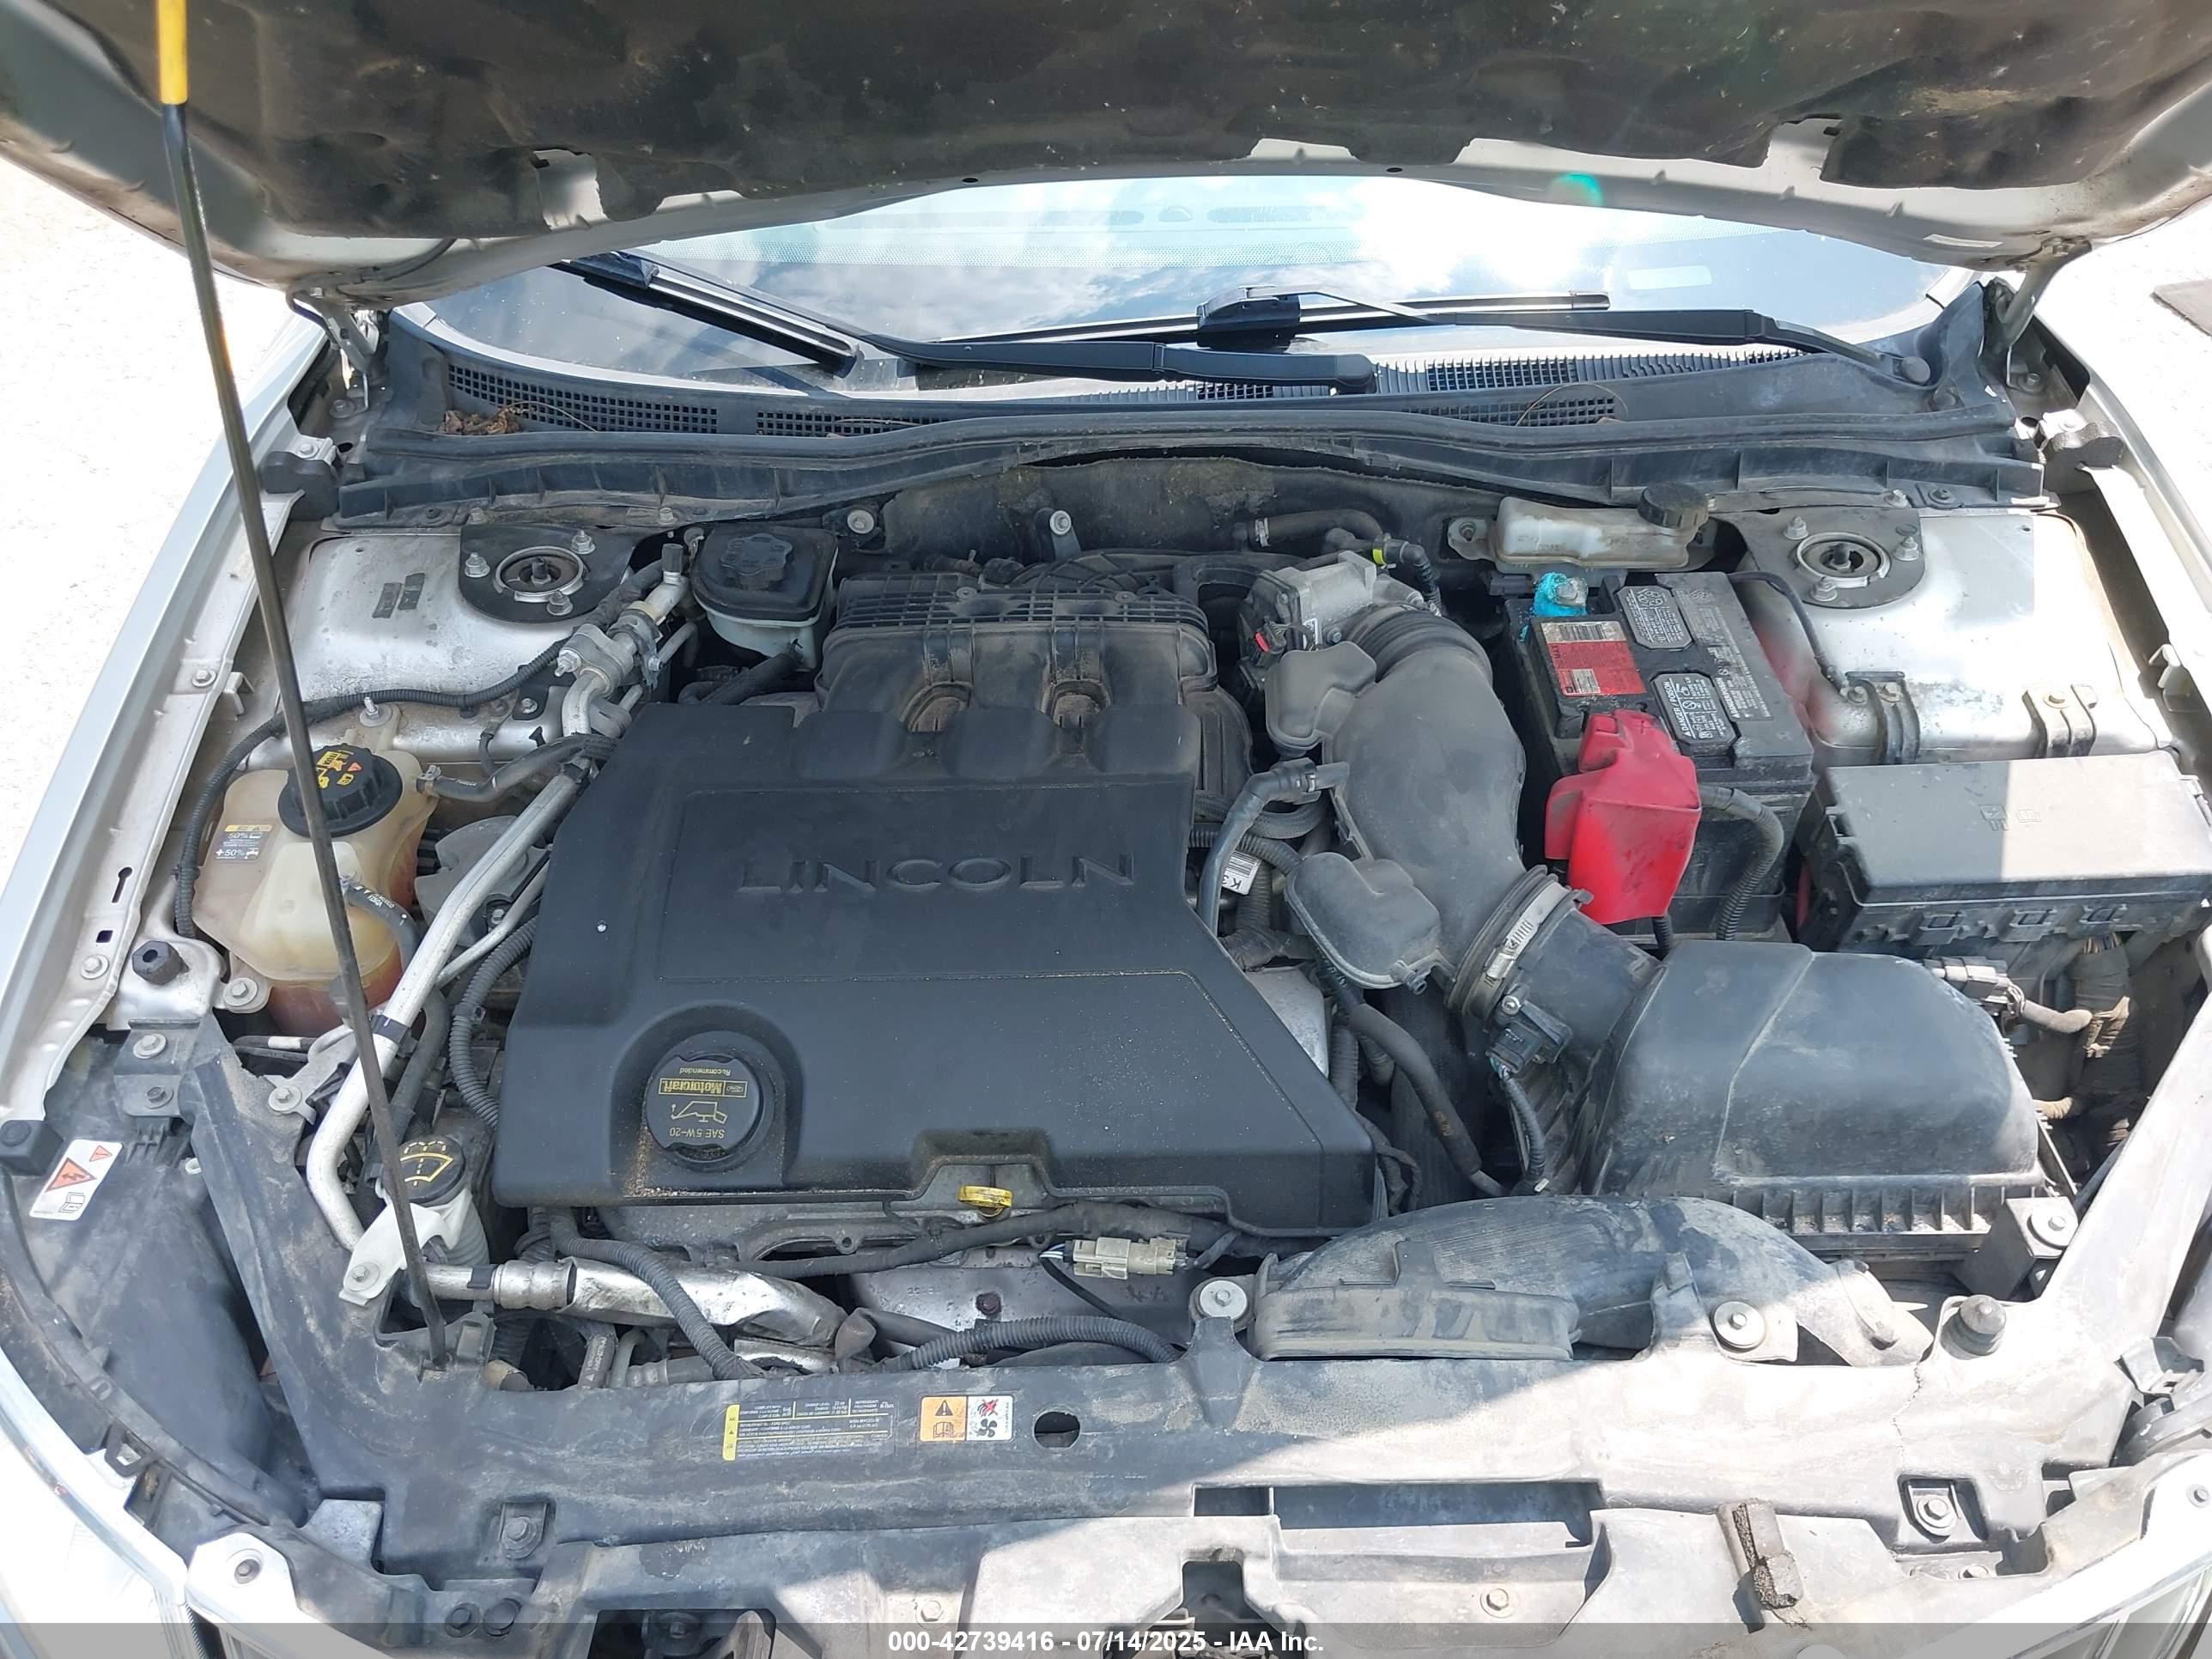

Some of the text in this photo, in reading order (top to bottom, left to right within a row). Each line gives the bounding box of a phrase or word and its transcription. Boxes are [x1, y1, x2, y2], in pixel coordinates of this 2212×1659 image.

[1662, 681, 1678, 702] POISON
[1673, 708, 1691, 732] DANGER
[737, 853, 1135, 894] LINCOLN
[679, 1067, 731, 1076] Recommended
[663, 1080, 722, 1094] Motorcraft
[669, 1127, 725, 1139] SAE 5W-20
